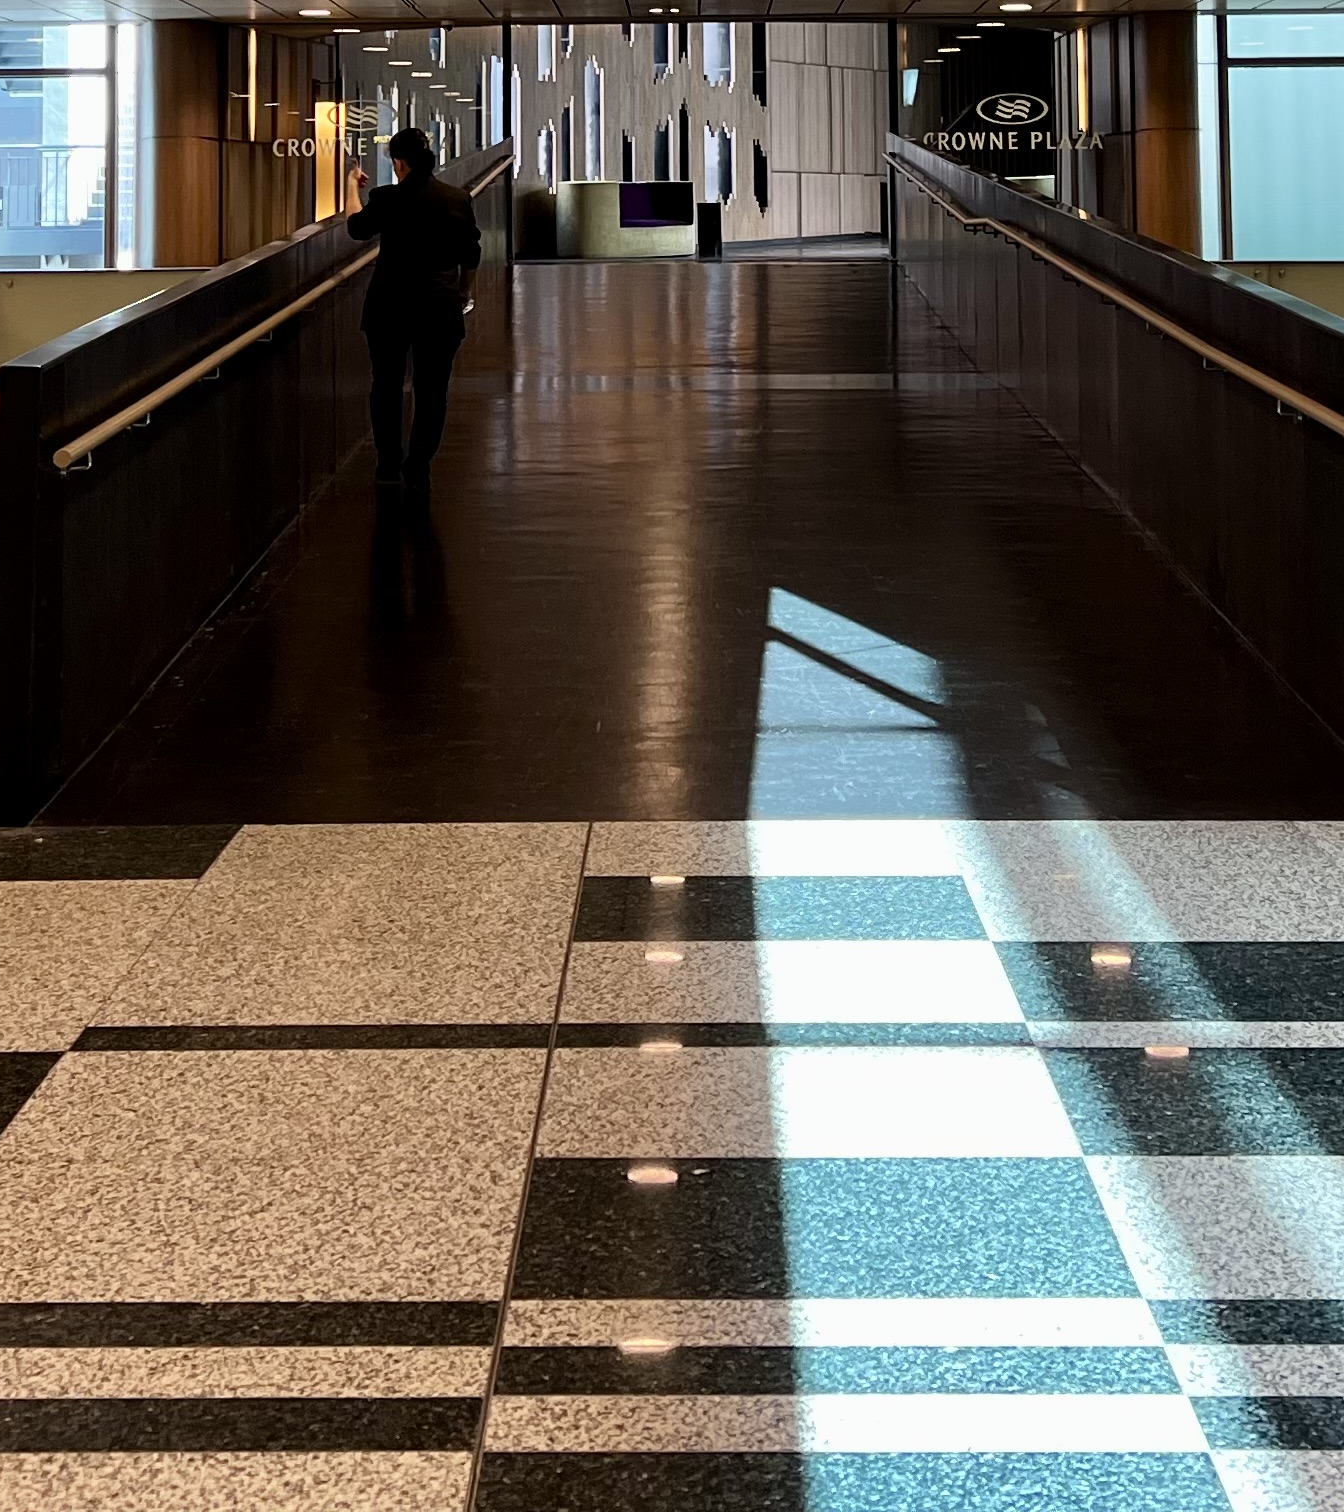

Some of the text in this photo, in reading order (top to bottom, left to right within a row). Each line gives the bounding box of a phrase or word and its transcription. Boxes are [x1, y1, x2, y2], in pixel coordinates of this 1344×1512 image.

[272, 136, 368, 157] CROWNE
[923, 131, 1104, 151] CROWNE PLAZA
